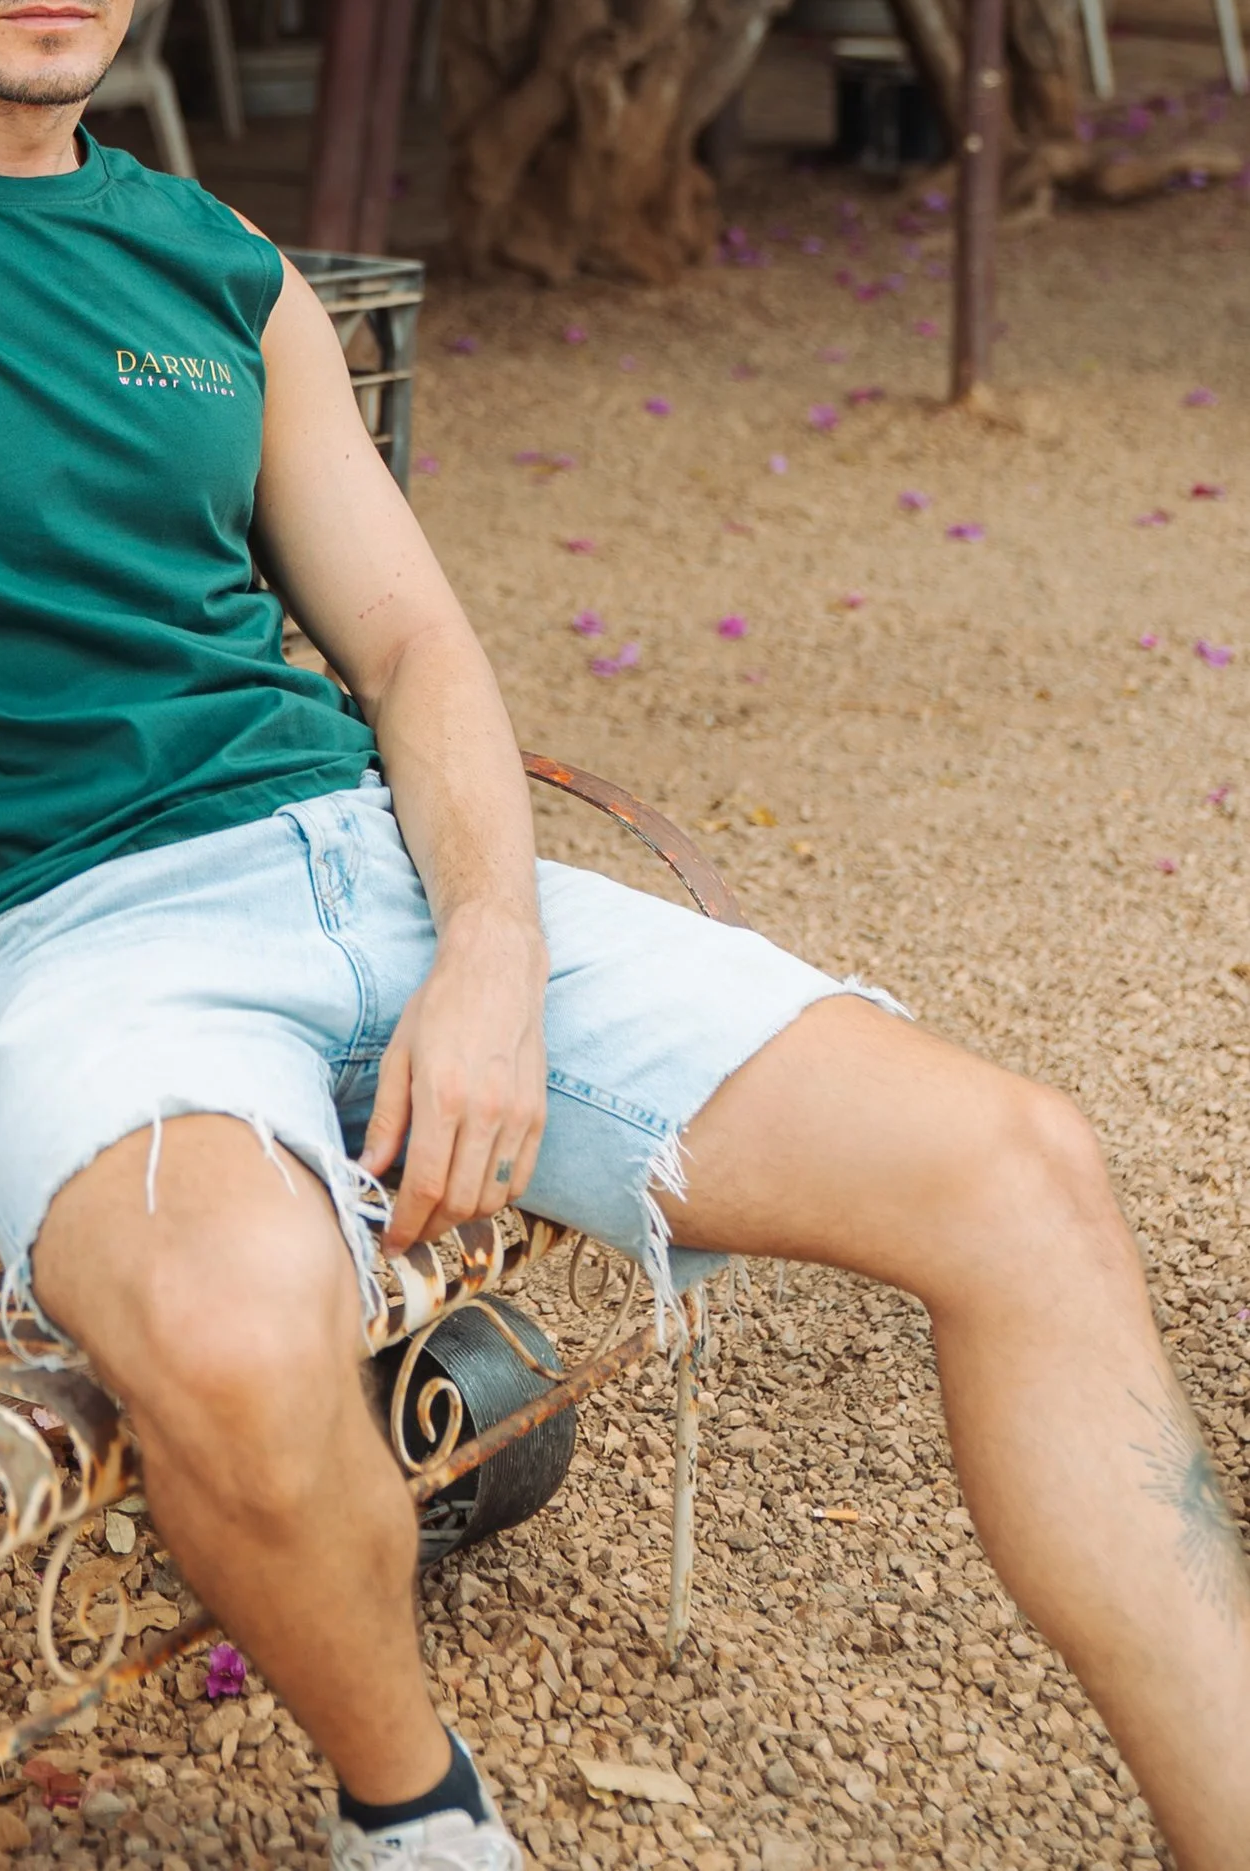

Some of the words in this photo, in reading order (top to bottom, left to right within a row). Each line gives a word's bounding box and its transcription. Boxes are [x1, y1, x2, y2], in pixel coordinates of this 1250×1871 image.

[116, 350, 232, 384] DARWIN
[118, 375, 179, 388] water
[191, 380, 236, 397] lilies
